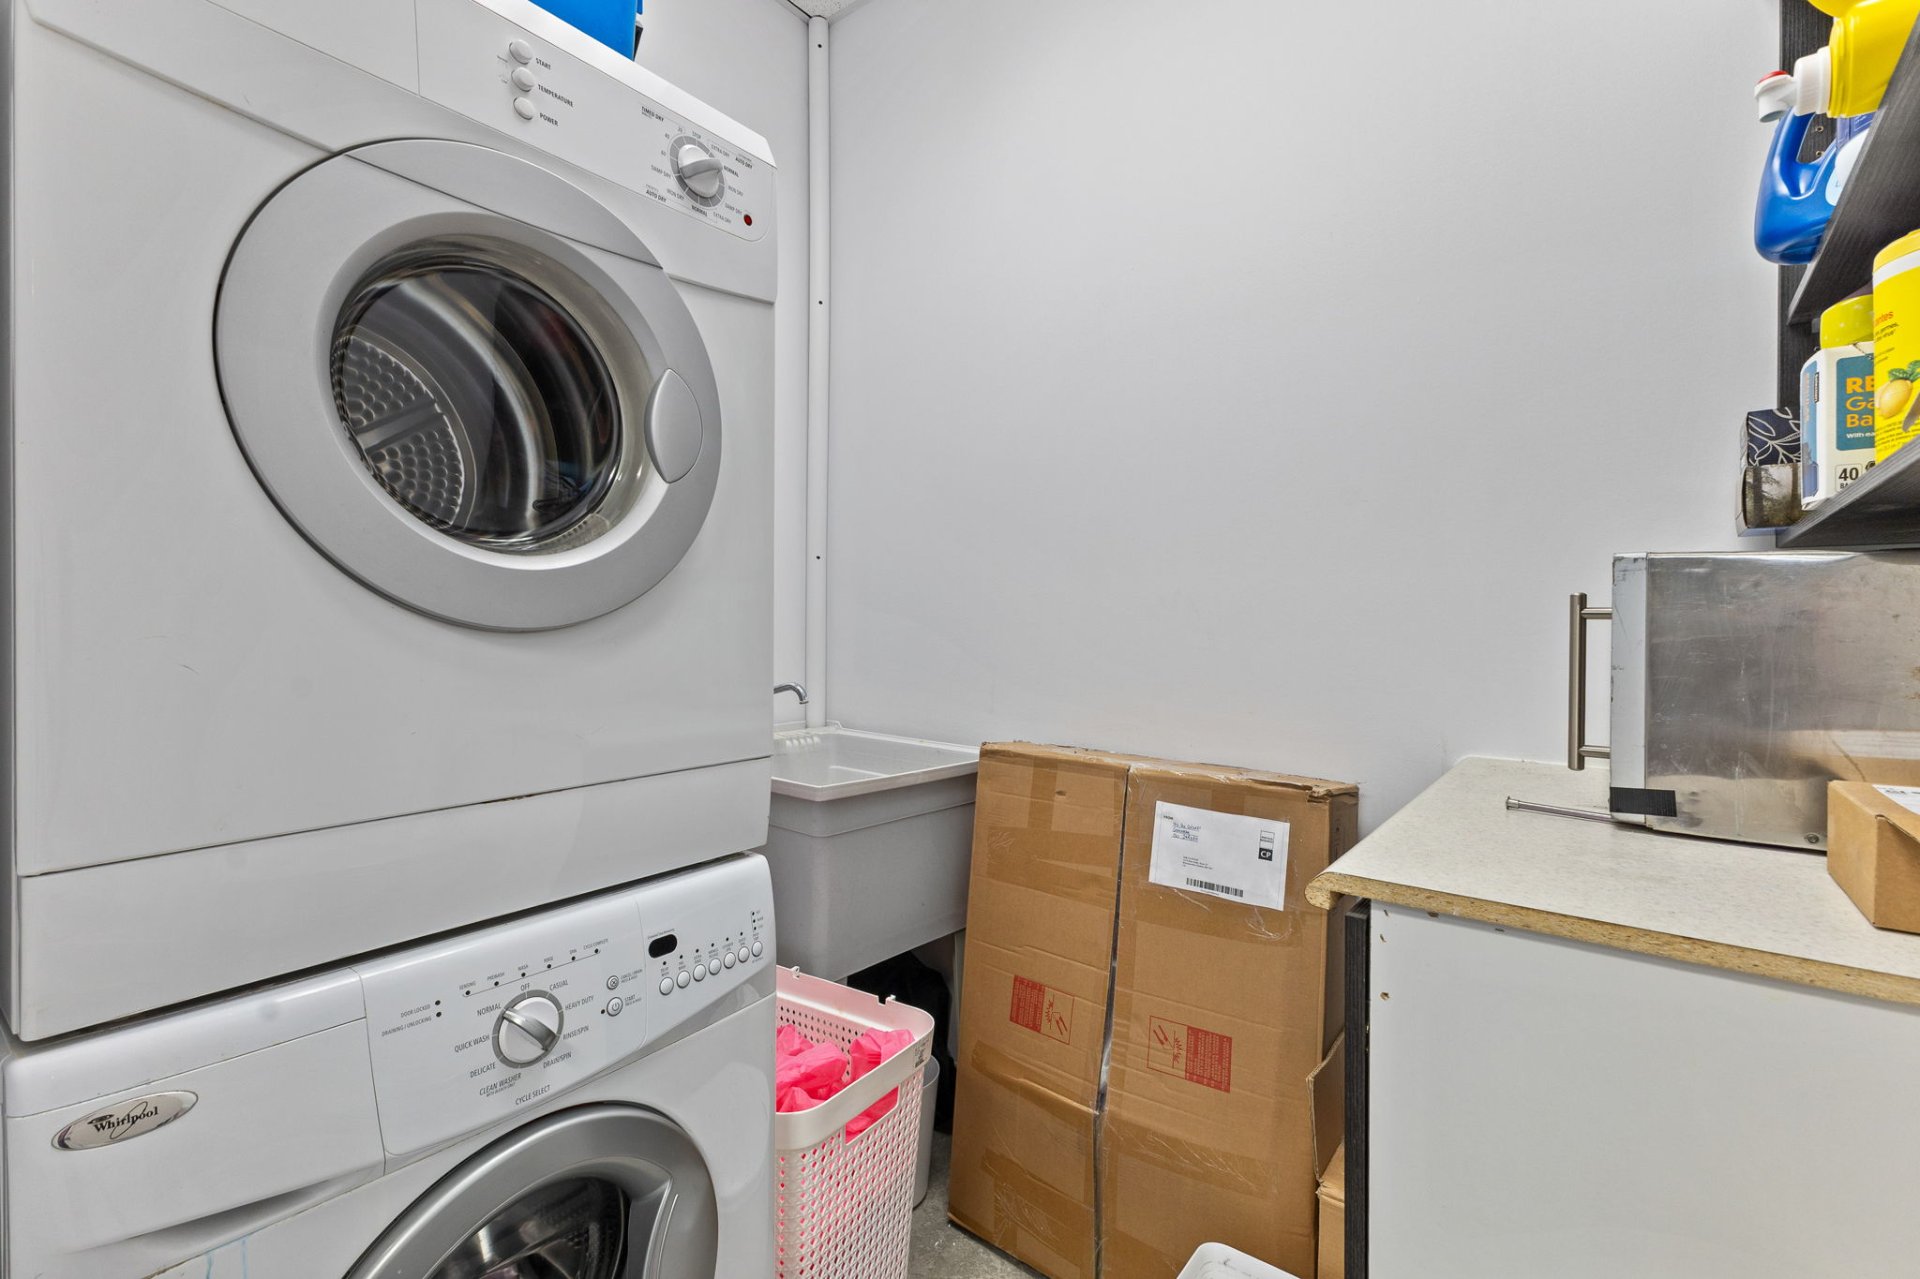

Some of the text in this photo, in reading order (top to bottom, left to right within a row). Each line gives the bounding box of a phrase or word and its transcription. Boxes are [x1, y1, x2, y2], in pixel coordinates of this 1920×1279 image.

[535, 57, 551, 70] START
[538, 83, 574, 107] TEMPERATURE
[539, 112, 559, 126] POWER
[655, 113, 664, 122] DRY
[723, 165, 740, 178] NORMAL
[646, 189, 667, 203] AUTO DRY
[691, 204, 708, 217] NORMAL
[1838, 467, 1859, 481] 40
[1260, 850, 1271, 858] CP
[520, 983, 531, 992] OFF
[549, 979, 568, 991] CASUAL
[477, 1002, 502, 1016] NORMAL
[565, 995, 594, 1011] HEAVY DUTY
[400, 1003, 431, 1018] DOOR LOCKED
[381, 1024, 404, 1037] DRAINING
[407, 1015, 432, 1029] UNLOCKING
[563, 1025, 590, 1040] RINSE/SPIN
[454, 1034, 490, 1054] QUICK WASH
[543, 1051, 572, 1069] DRAIN/SPIN
[470, 1062, 496, 1079] DELICATE
[479, 1072, 522, 1096] CLEAN WASHER
[515, 1085, 551, 1106] CYCLE SELECT
[93, 1104, 160, 1136] Whirlpool
